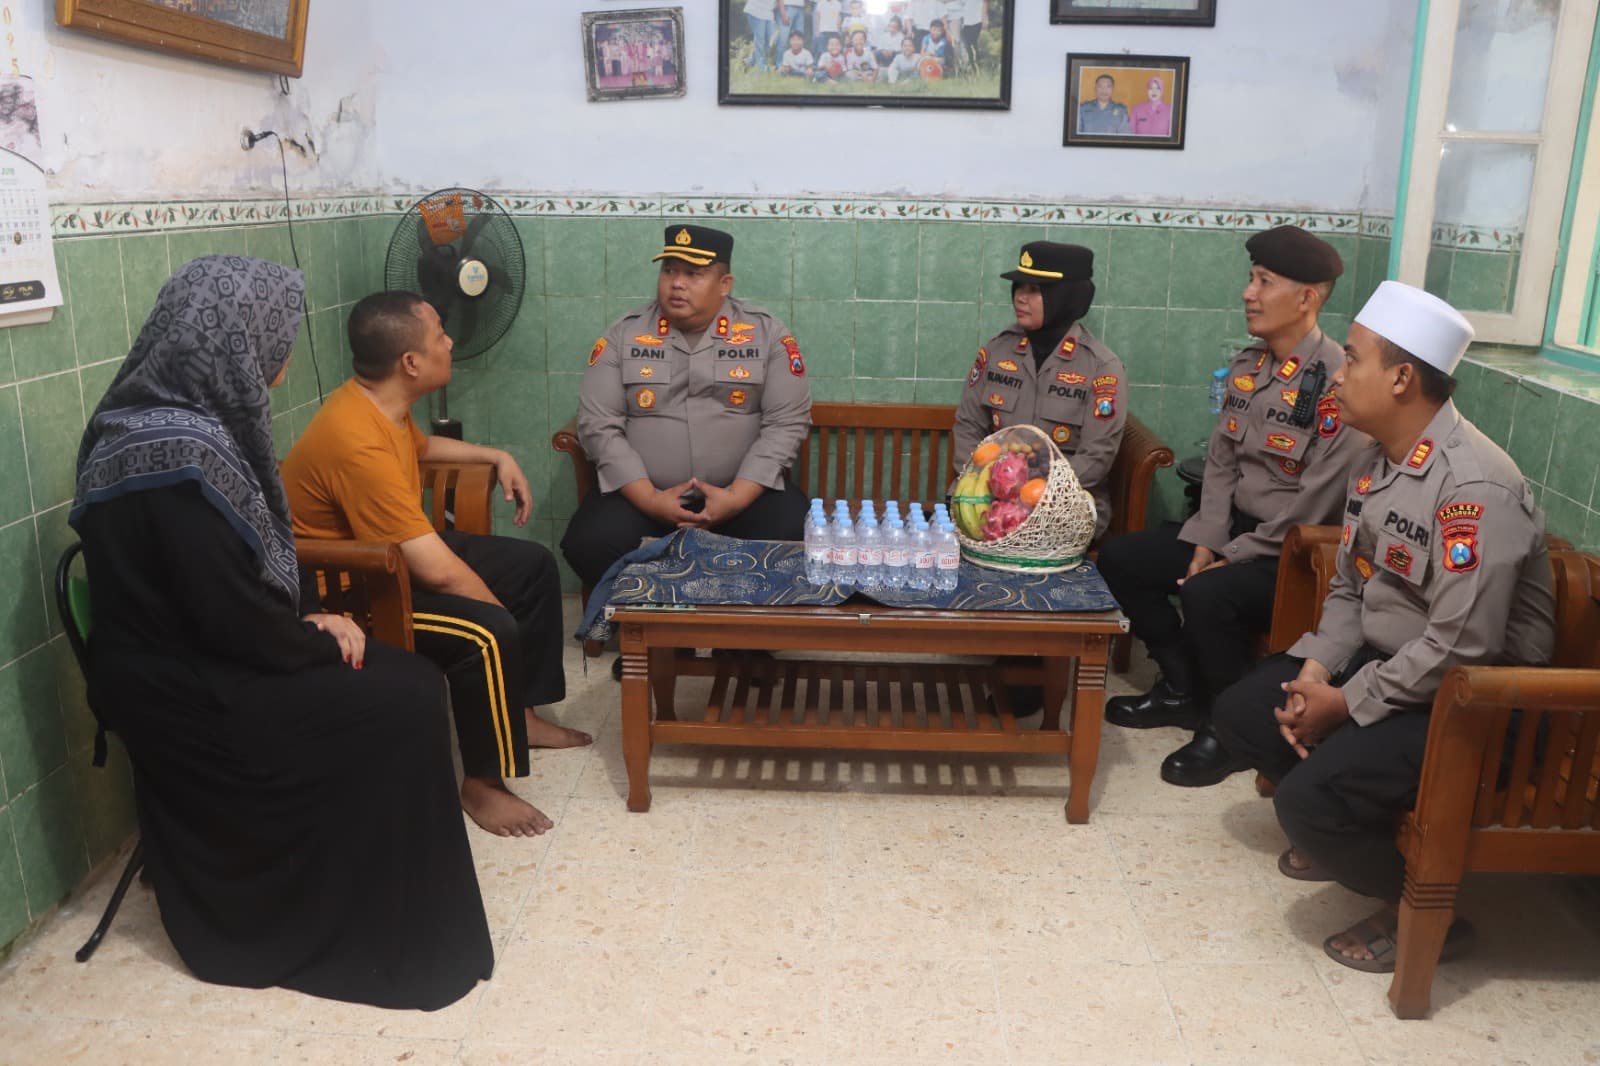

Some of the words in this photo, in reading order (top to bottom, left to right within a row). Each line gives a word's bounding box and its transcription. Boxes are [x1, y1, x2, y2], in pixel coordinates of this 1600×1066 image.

[631, 347, 665, 360] DANI
[718, 348, 760, 360] POLRI
[1047, 384, 1089, 401] POLRI
[1266, 407, 1307, 430] POL
[1384, 510, 1429, 548] POLRI
